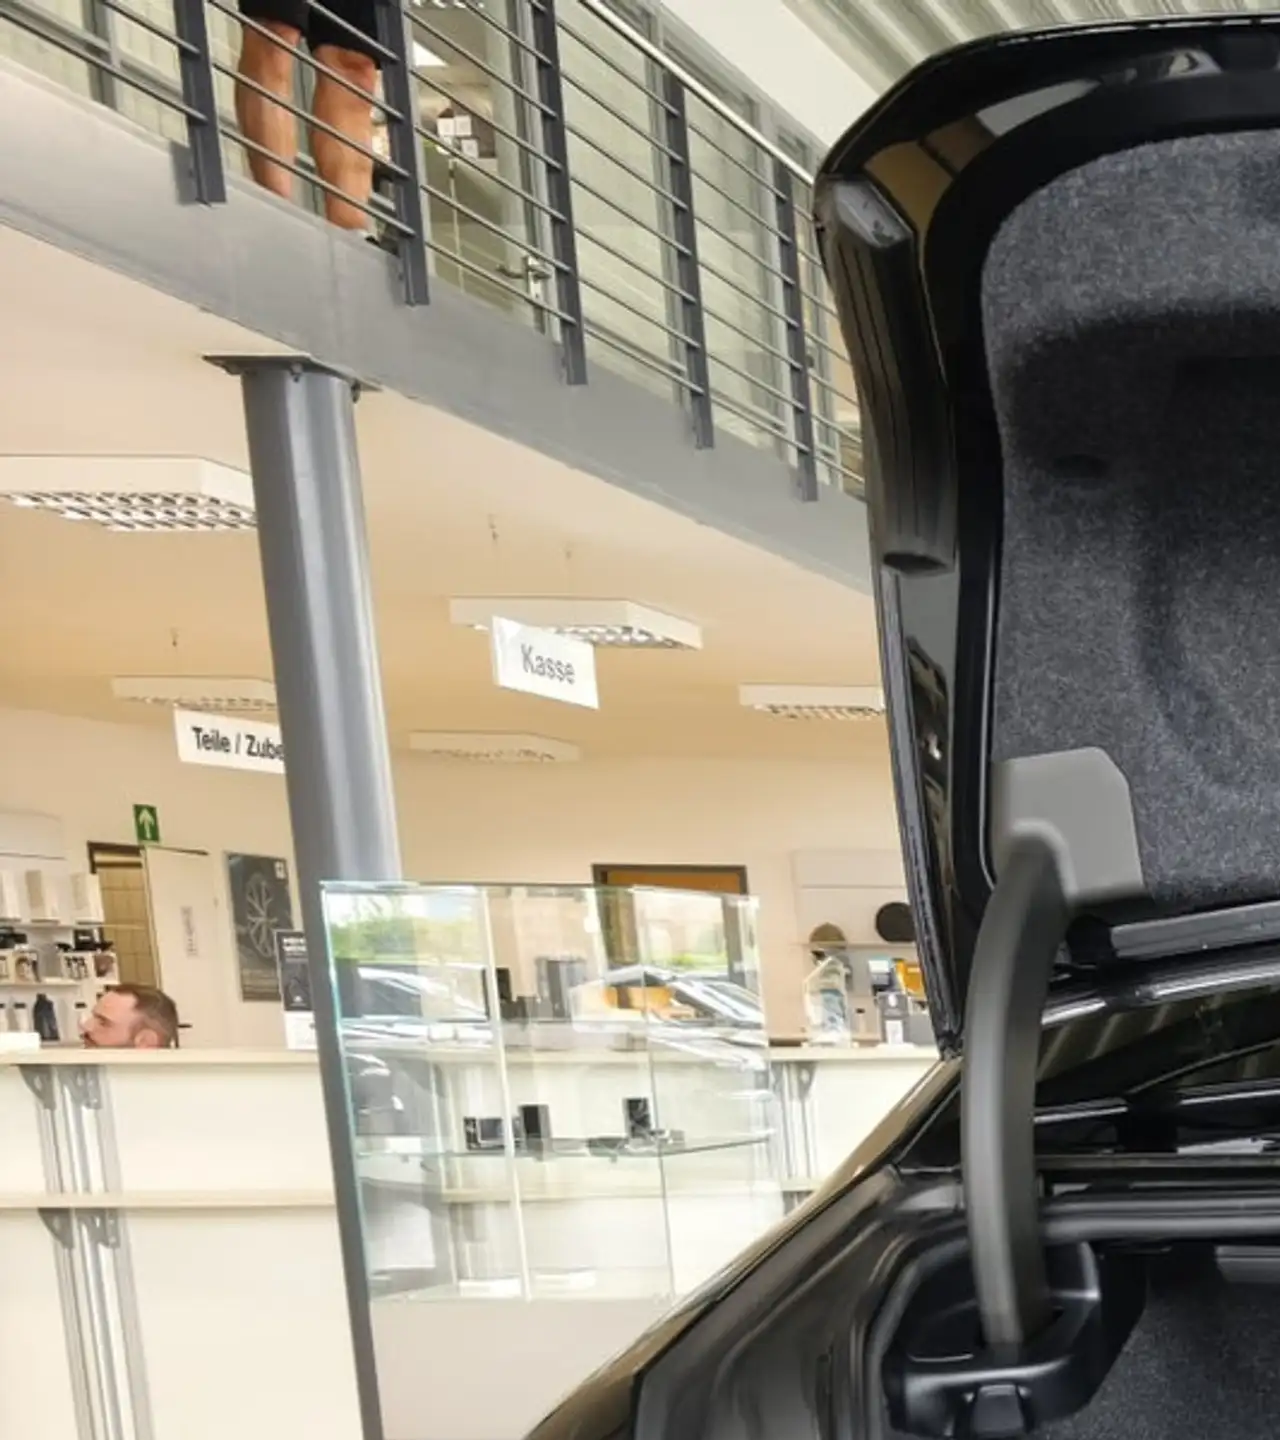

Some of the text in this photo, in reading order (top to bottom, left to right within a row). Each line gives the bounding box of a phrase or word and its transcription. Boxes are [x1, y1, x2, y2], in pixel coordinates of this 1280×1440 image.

[520, 643, 576, 686] Kasse
[191, 726, 231, 753] Teile
[235, 732, 242, 755] /
